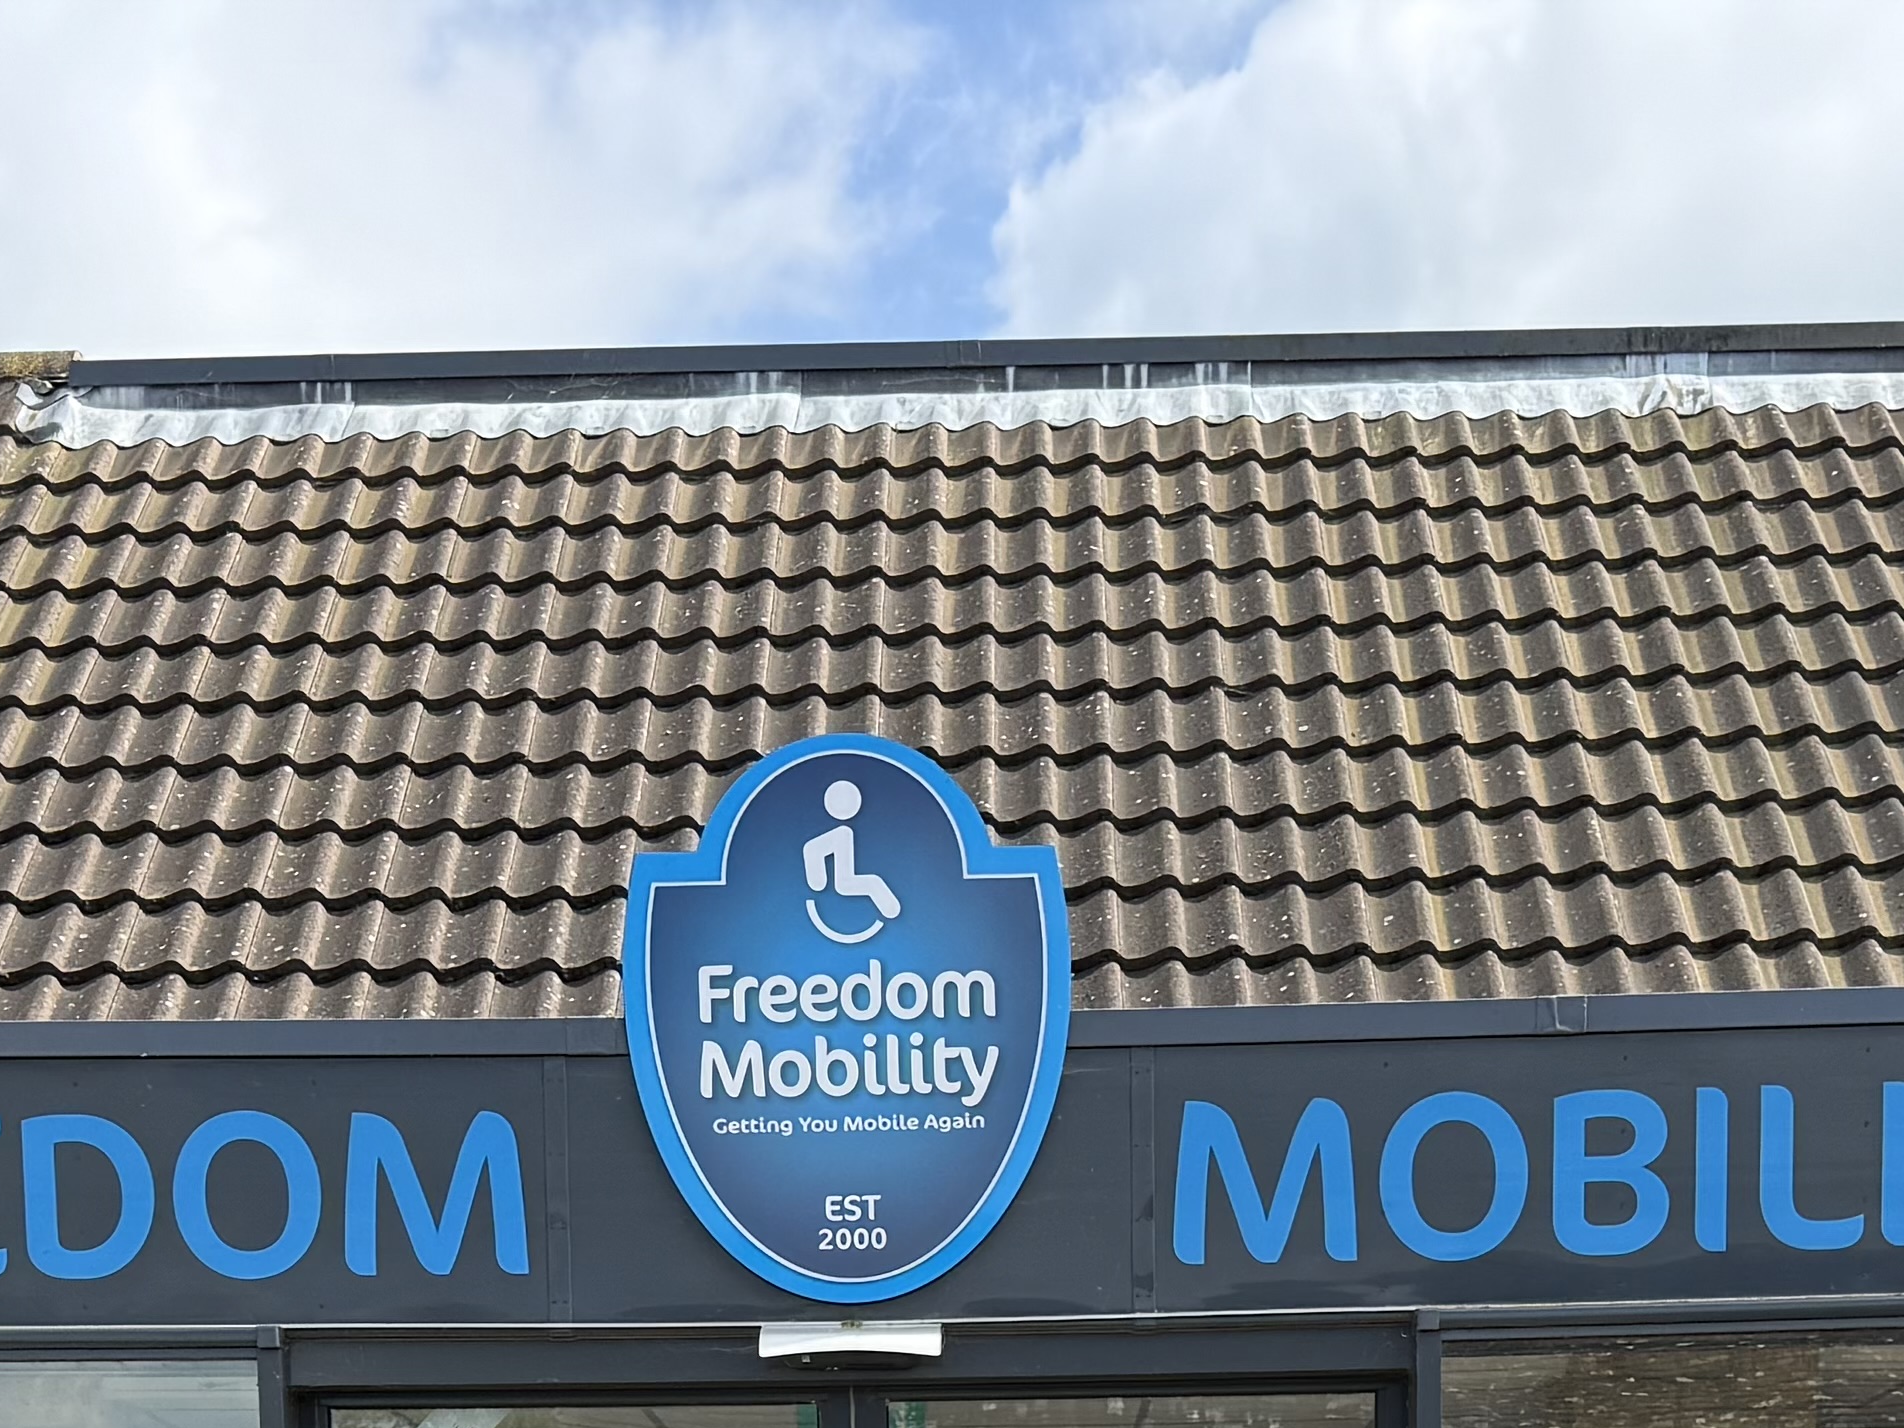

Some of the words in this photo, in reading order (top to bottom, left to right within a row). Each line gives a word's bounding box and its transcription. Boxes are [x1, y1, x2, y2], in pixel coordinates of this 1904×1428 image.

[697, 958, 997, 1024] Freedom
[699, 1031, 1000, 1107] Mobility
[711, 1115, 794, 1136] Getting
[798, 1116, 839, 1132] You
[843, 1113, 920, 1132] Mobile
[923, 1111, 986, 1133] Again
[824, 1194, 883, 1223] EST
[817, 1227, 888, 1251] 2000
